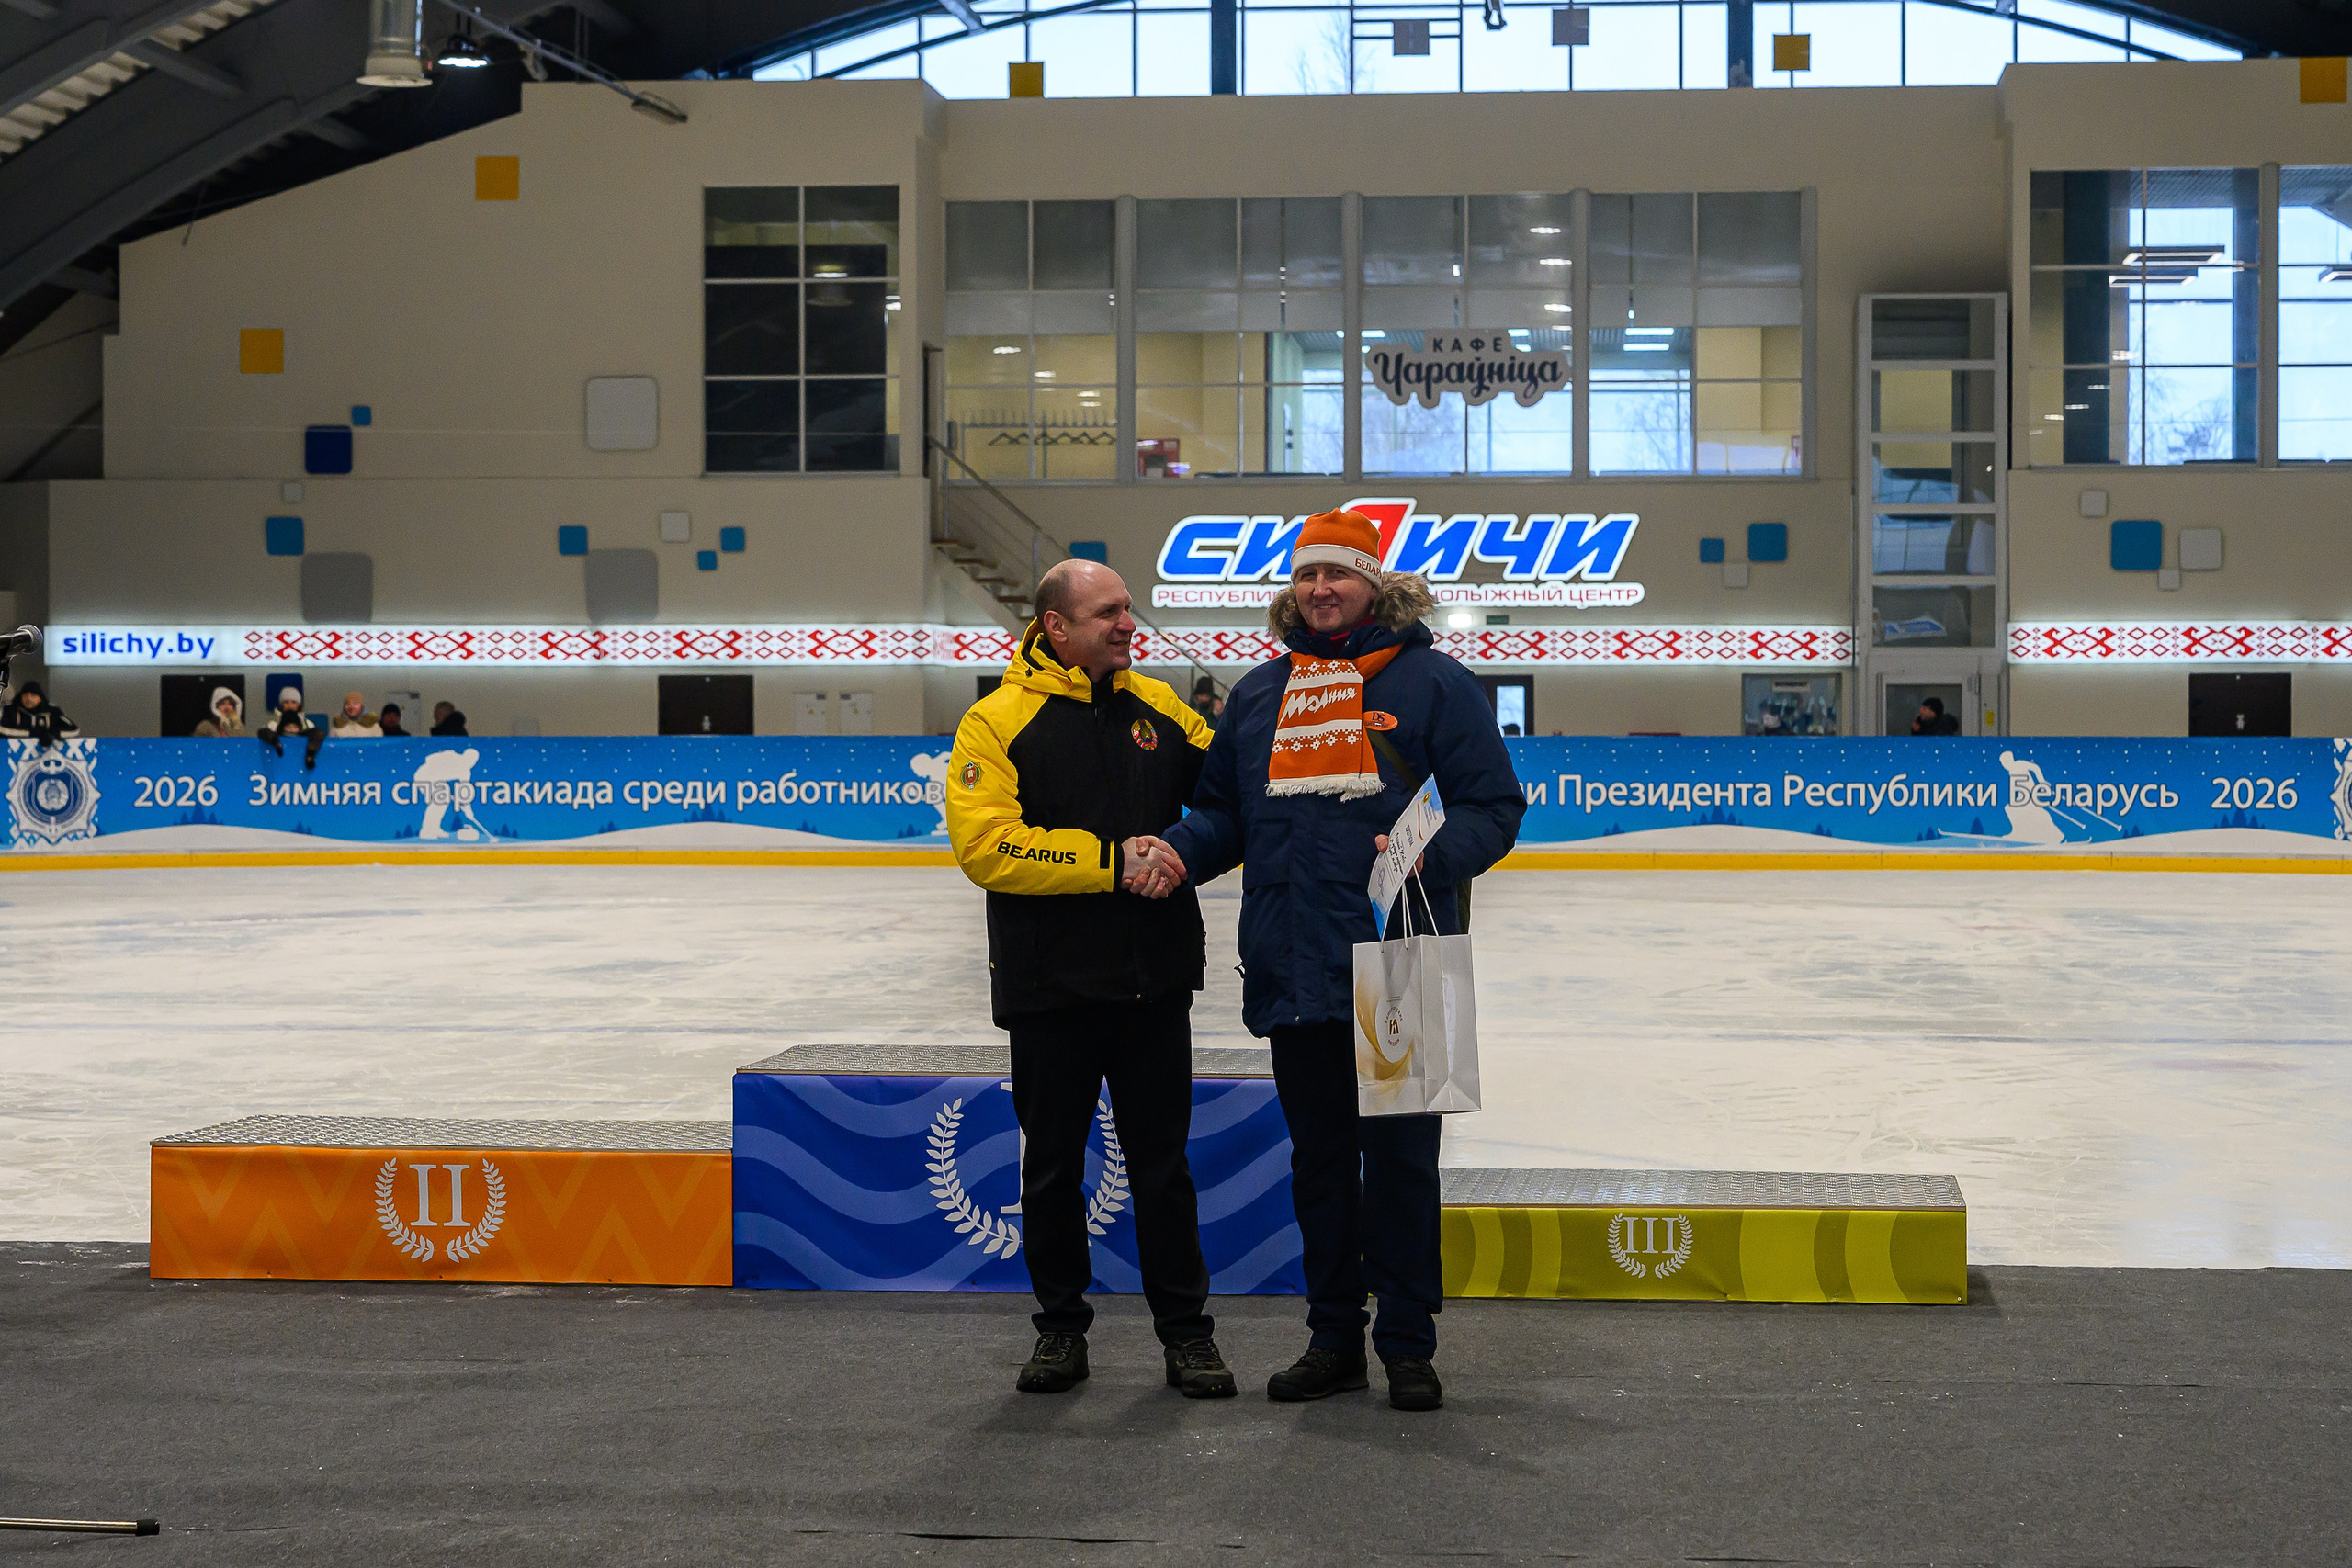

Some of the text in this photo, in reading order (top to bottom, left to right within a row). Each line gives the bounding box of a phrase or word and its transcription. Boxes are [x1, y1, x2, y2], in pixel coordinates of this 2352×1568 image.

[1432, 337, 1503, 352] КАФЕ
[1158, 590, 1278, 603] РЕСПУБЛИ
[1569, 589, 1639, 607] ЦЕНТР
[62, 632, 215, 660] silichy.by
[1277, 687, 1357, 728] Молния
[133, 775, 219, 807] 2026
[248, 772, 2180, 817] Зимняя спартакиада среди работников и Президента Республики Беларусь
[2211, 777, 2298, 810] 2026
[409, 1163, 470, 1226] II
[1623, 1216, 1679, 1254] III
